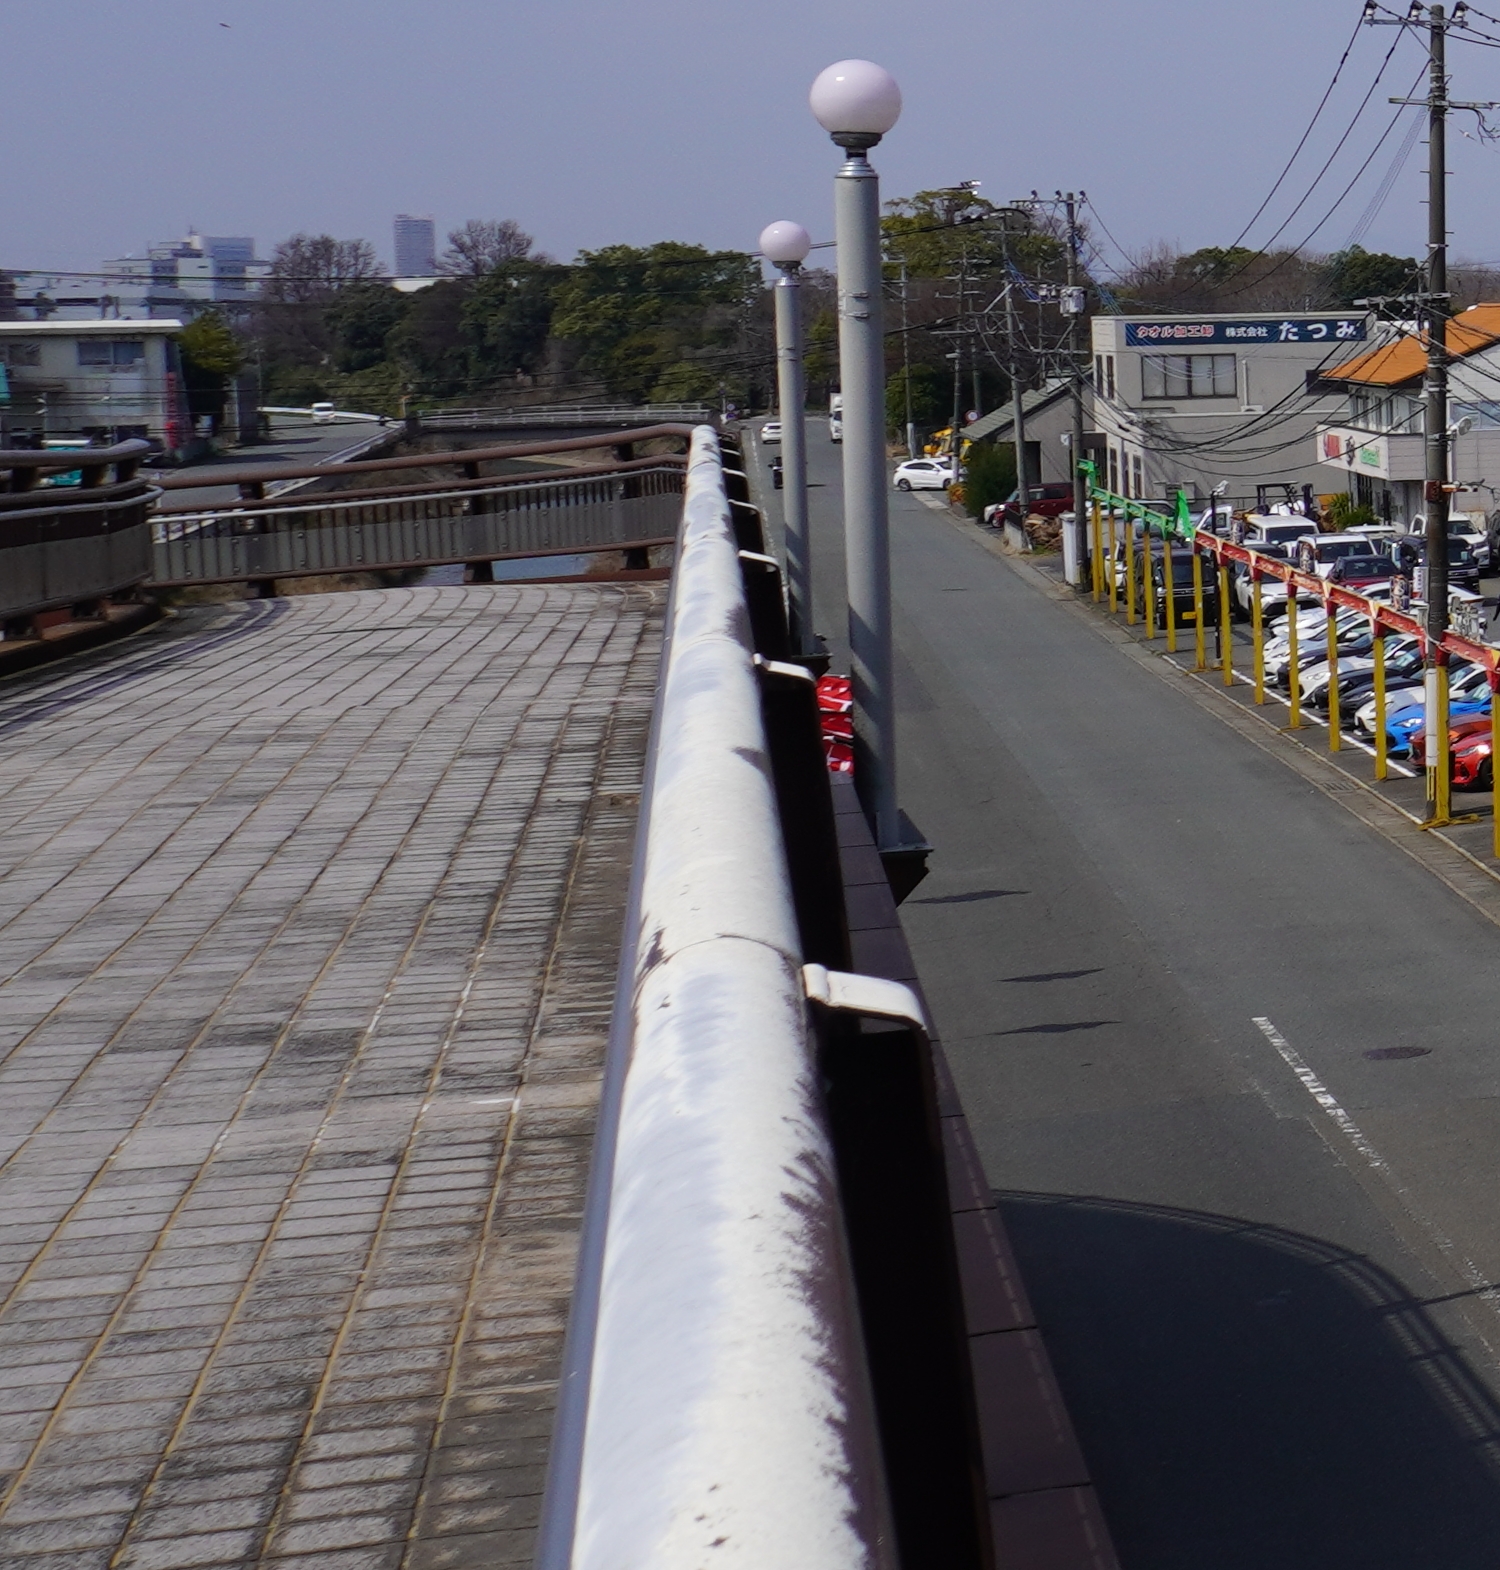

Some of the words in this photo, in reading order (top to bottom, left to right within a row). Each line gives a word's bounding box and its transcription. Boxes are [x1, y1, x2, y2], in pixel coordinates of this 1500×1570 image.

[1225, 326, 1268, 337] 株式会社
[1278, 321, 1357, 340] たつみ
